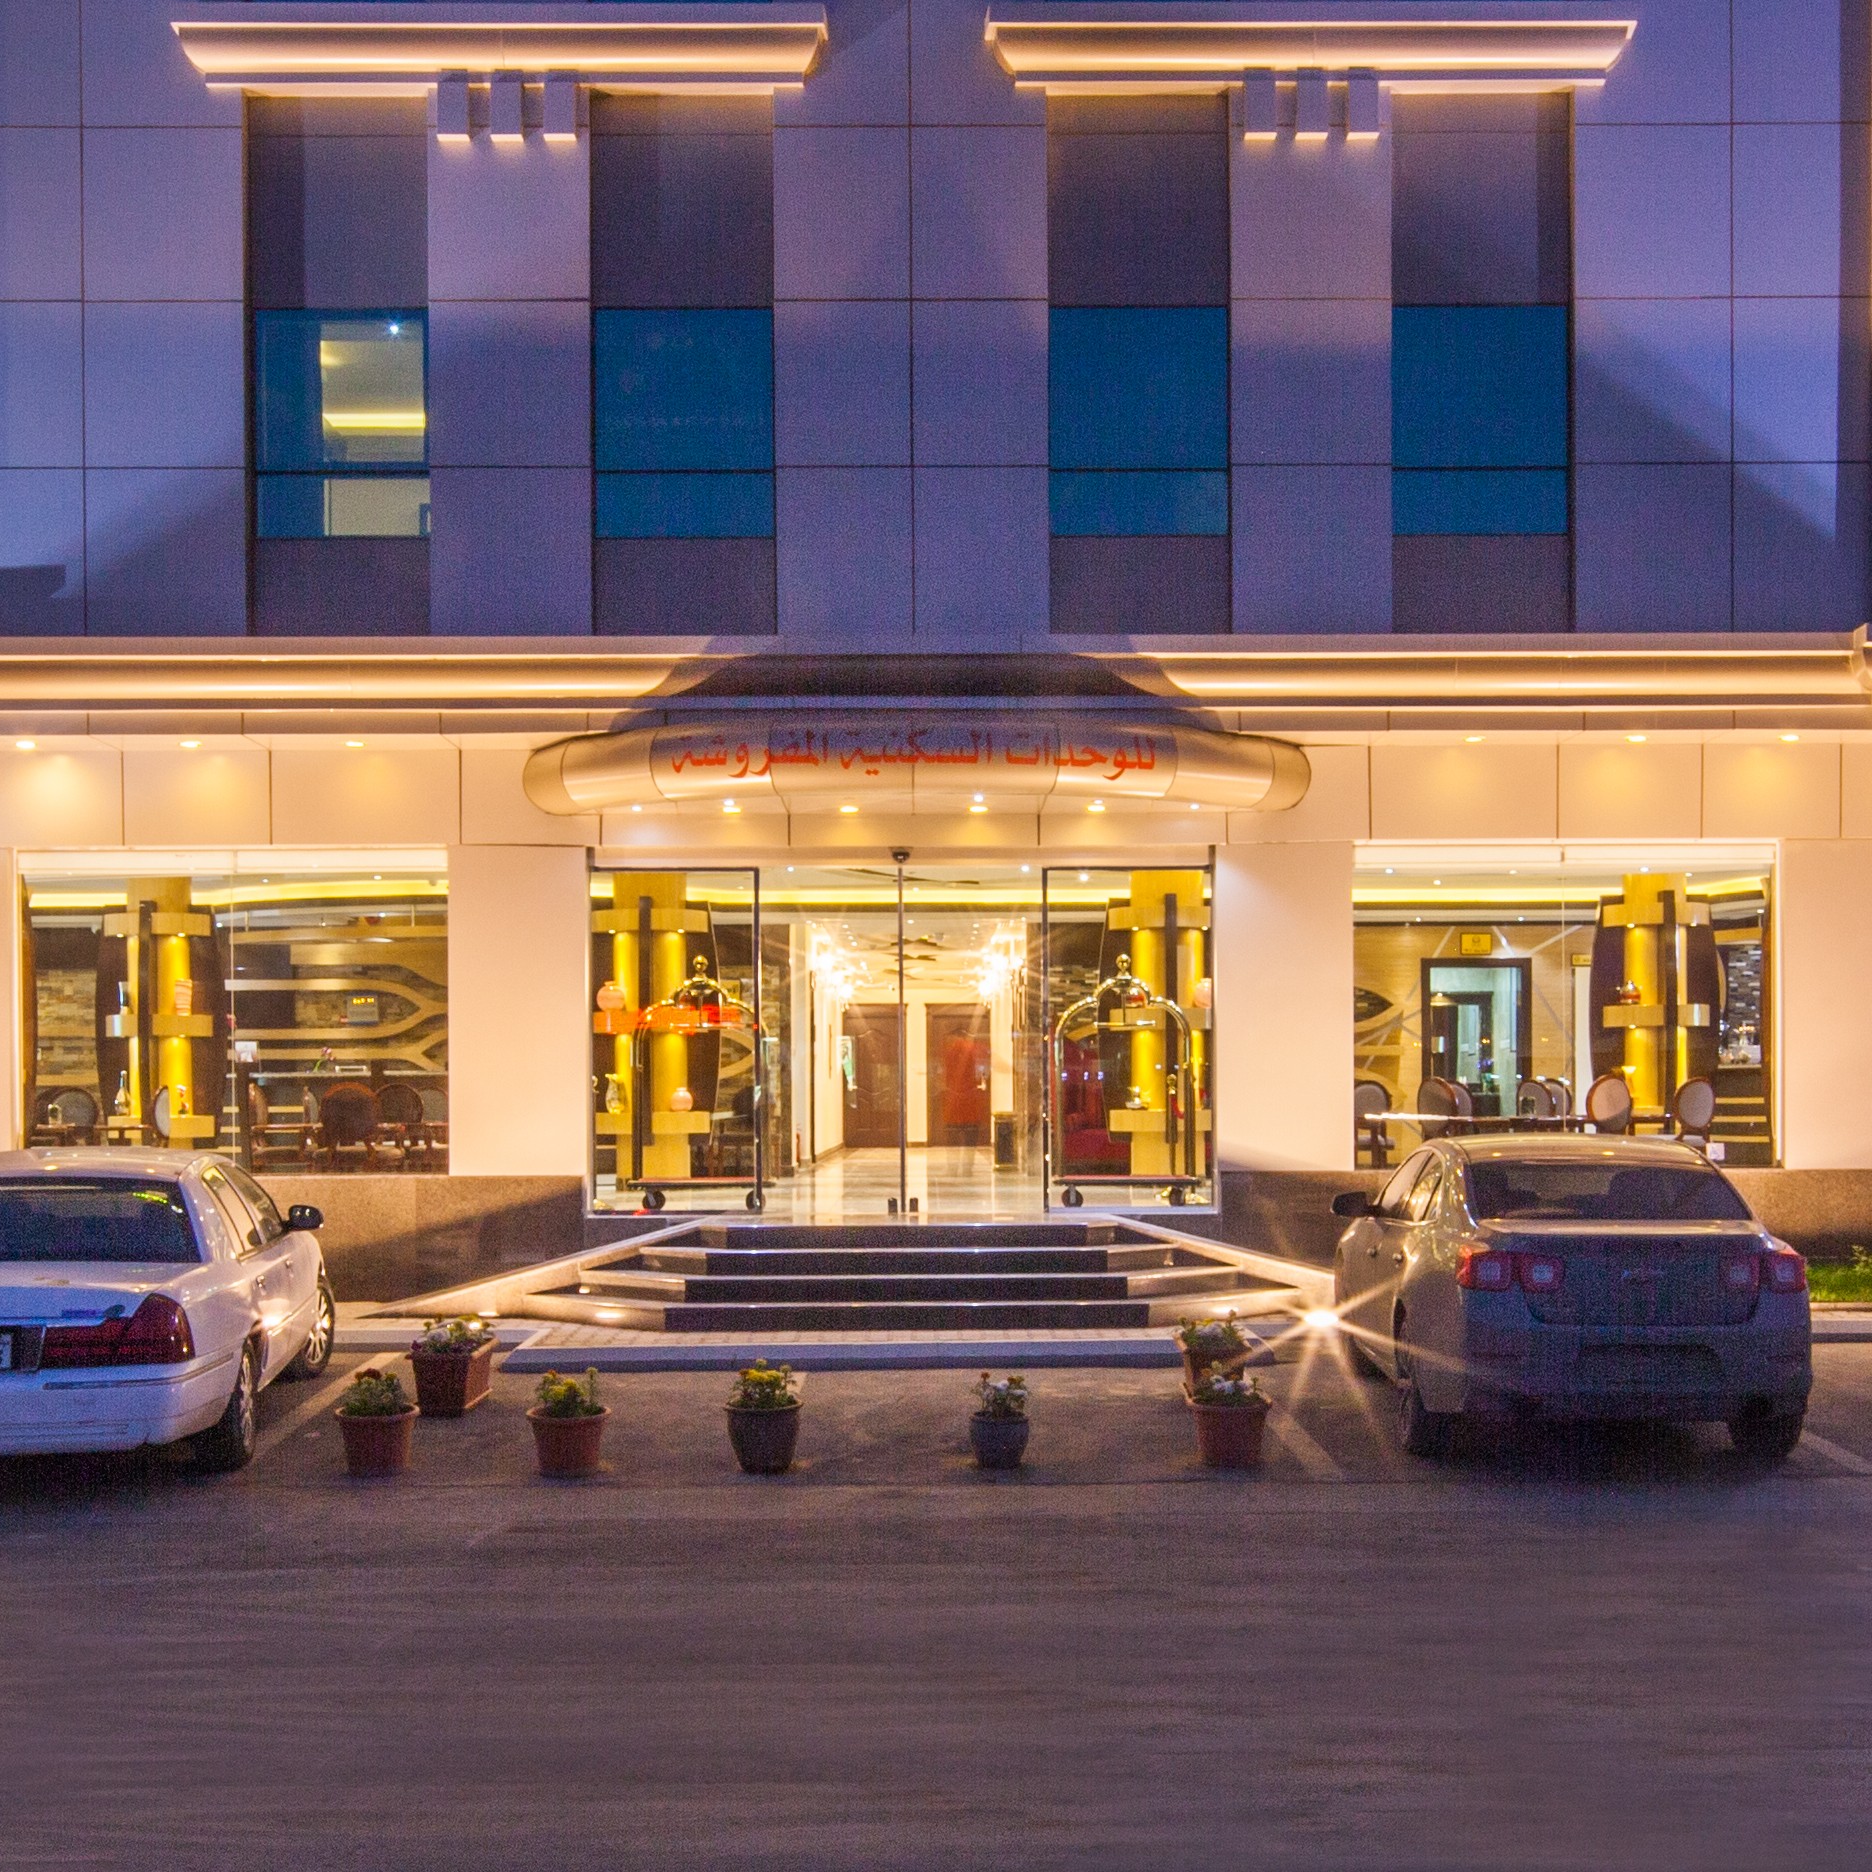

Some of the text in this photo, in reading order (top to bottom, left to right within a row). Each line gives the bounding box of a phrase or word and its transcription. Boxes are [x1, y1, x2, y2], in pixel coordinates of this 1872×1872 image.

[671, 724, 1156, 781] للوحدات السكنية المفروشة
